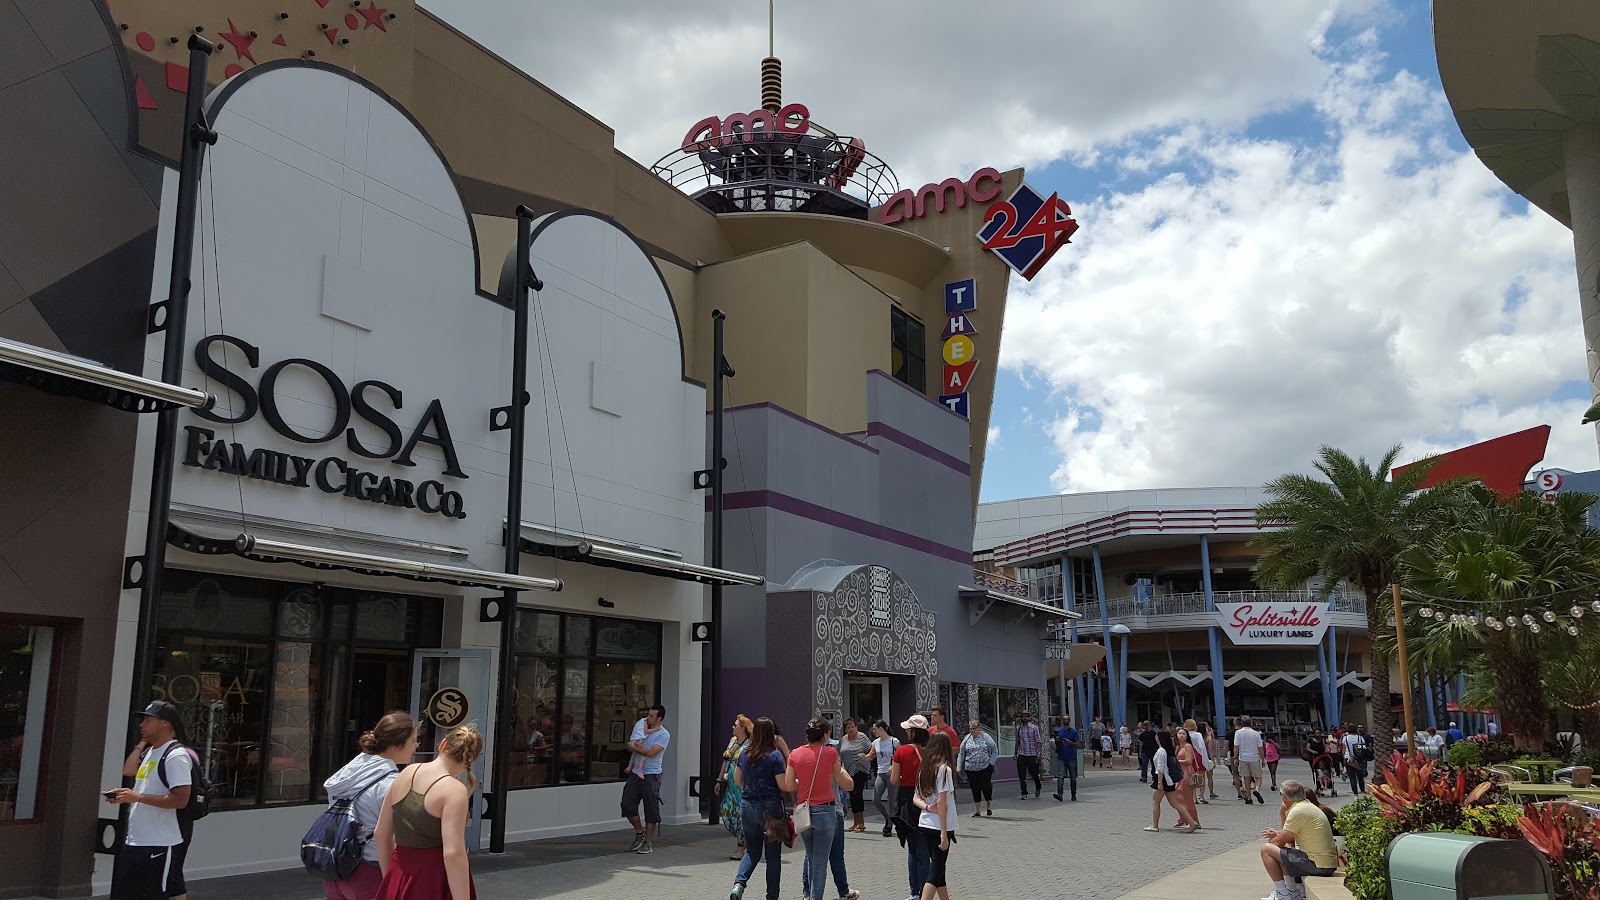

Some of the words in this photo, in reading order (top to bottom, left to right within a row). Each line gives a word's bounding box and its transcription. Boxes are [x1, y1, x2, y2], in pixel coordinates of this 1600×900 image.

[681, 103, 811, 154] amc
[876, 167, 1003, 225] amc
[981, 191, 1077, 251] 24
[189, 334, 470, 479] SOSA
[182, 425, 316, 488] FAMILY
[315, 456, 416, 509] CIGAR
[1229, 605, 1321, 637] Splitsville
[1249, 630, 1284, 638] LUXURY
[1287, 630, 1314, 638] LANES
